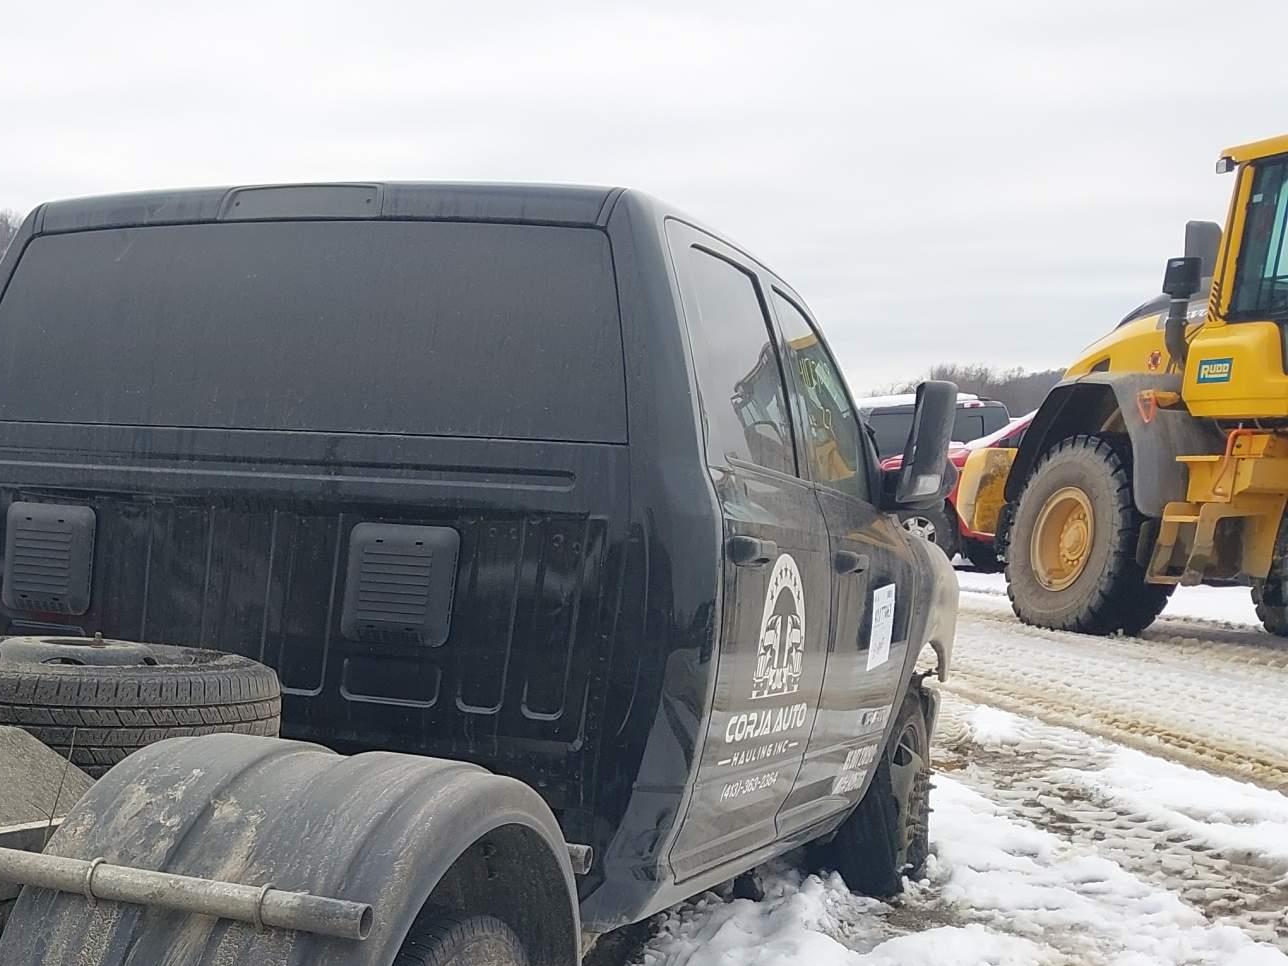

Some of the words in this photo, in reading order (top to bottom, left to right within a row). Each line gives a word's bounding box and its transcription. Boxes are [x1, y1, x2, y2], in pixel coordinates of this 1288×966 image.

[1200, 363, 1230, 379] RUDD
[725, 709, 772, 743] CORJA
[772, 702, 807, 733] AUTO
[731, 744, 773, 766] HAULING
[773, 740, 789, 756] INC
